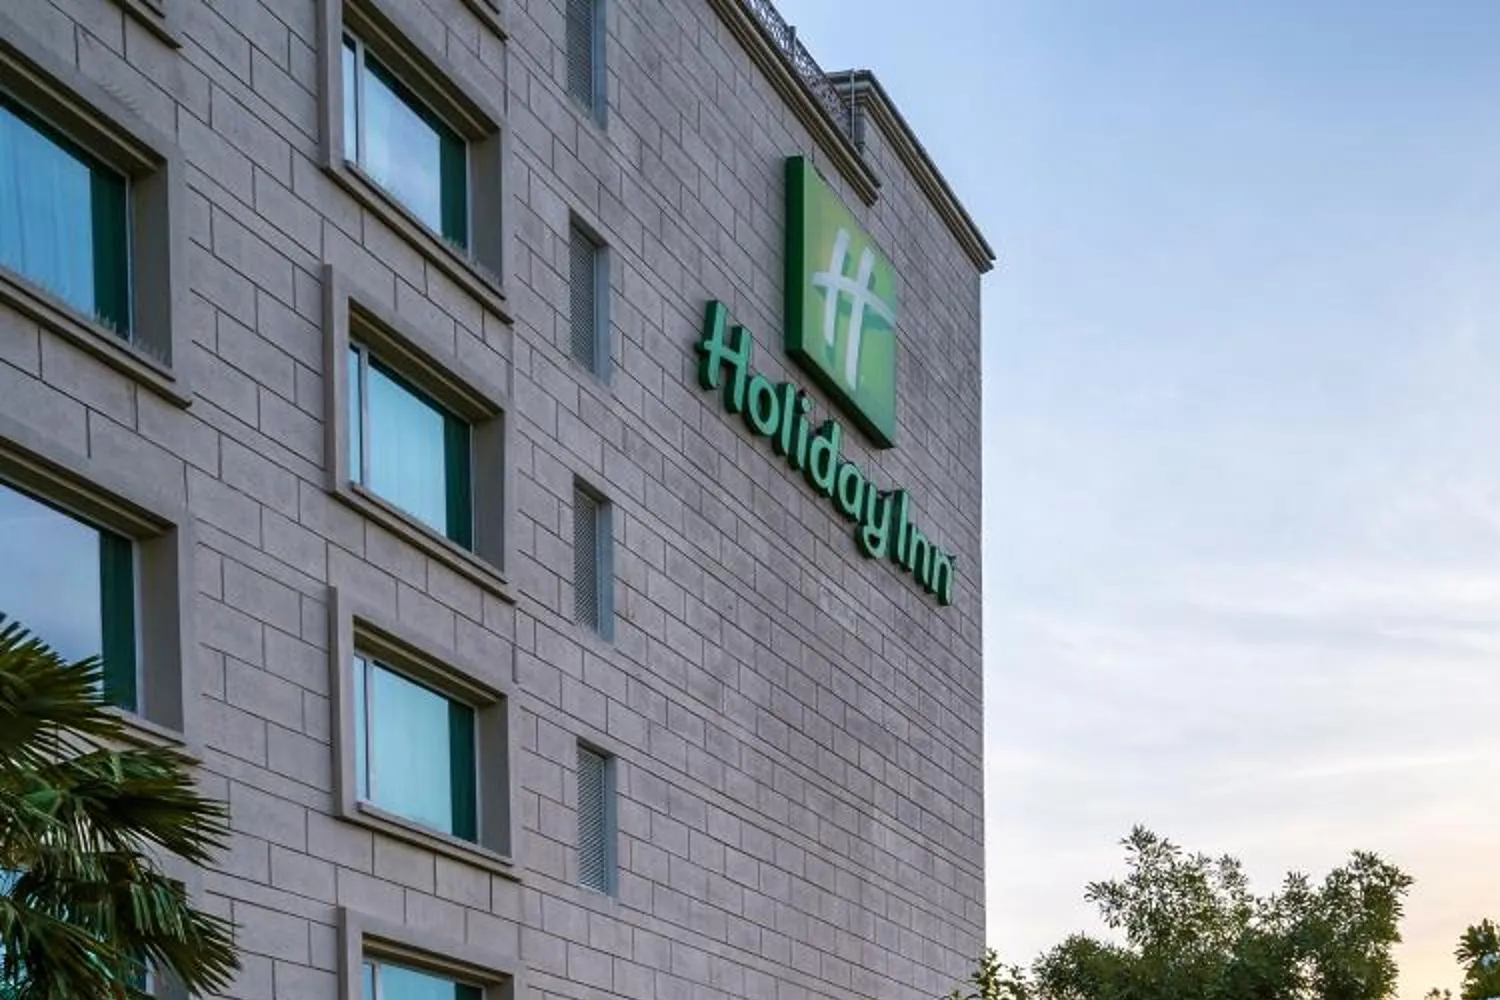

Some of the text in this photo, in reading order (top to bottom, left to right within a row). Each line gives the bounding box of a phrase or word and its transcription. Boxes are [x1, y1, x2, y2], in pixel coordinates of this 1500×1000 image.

[812, 228, 897, 393] H
[697, 299, 955, 606] Holiday Inn
